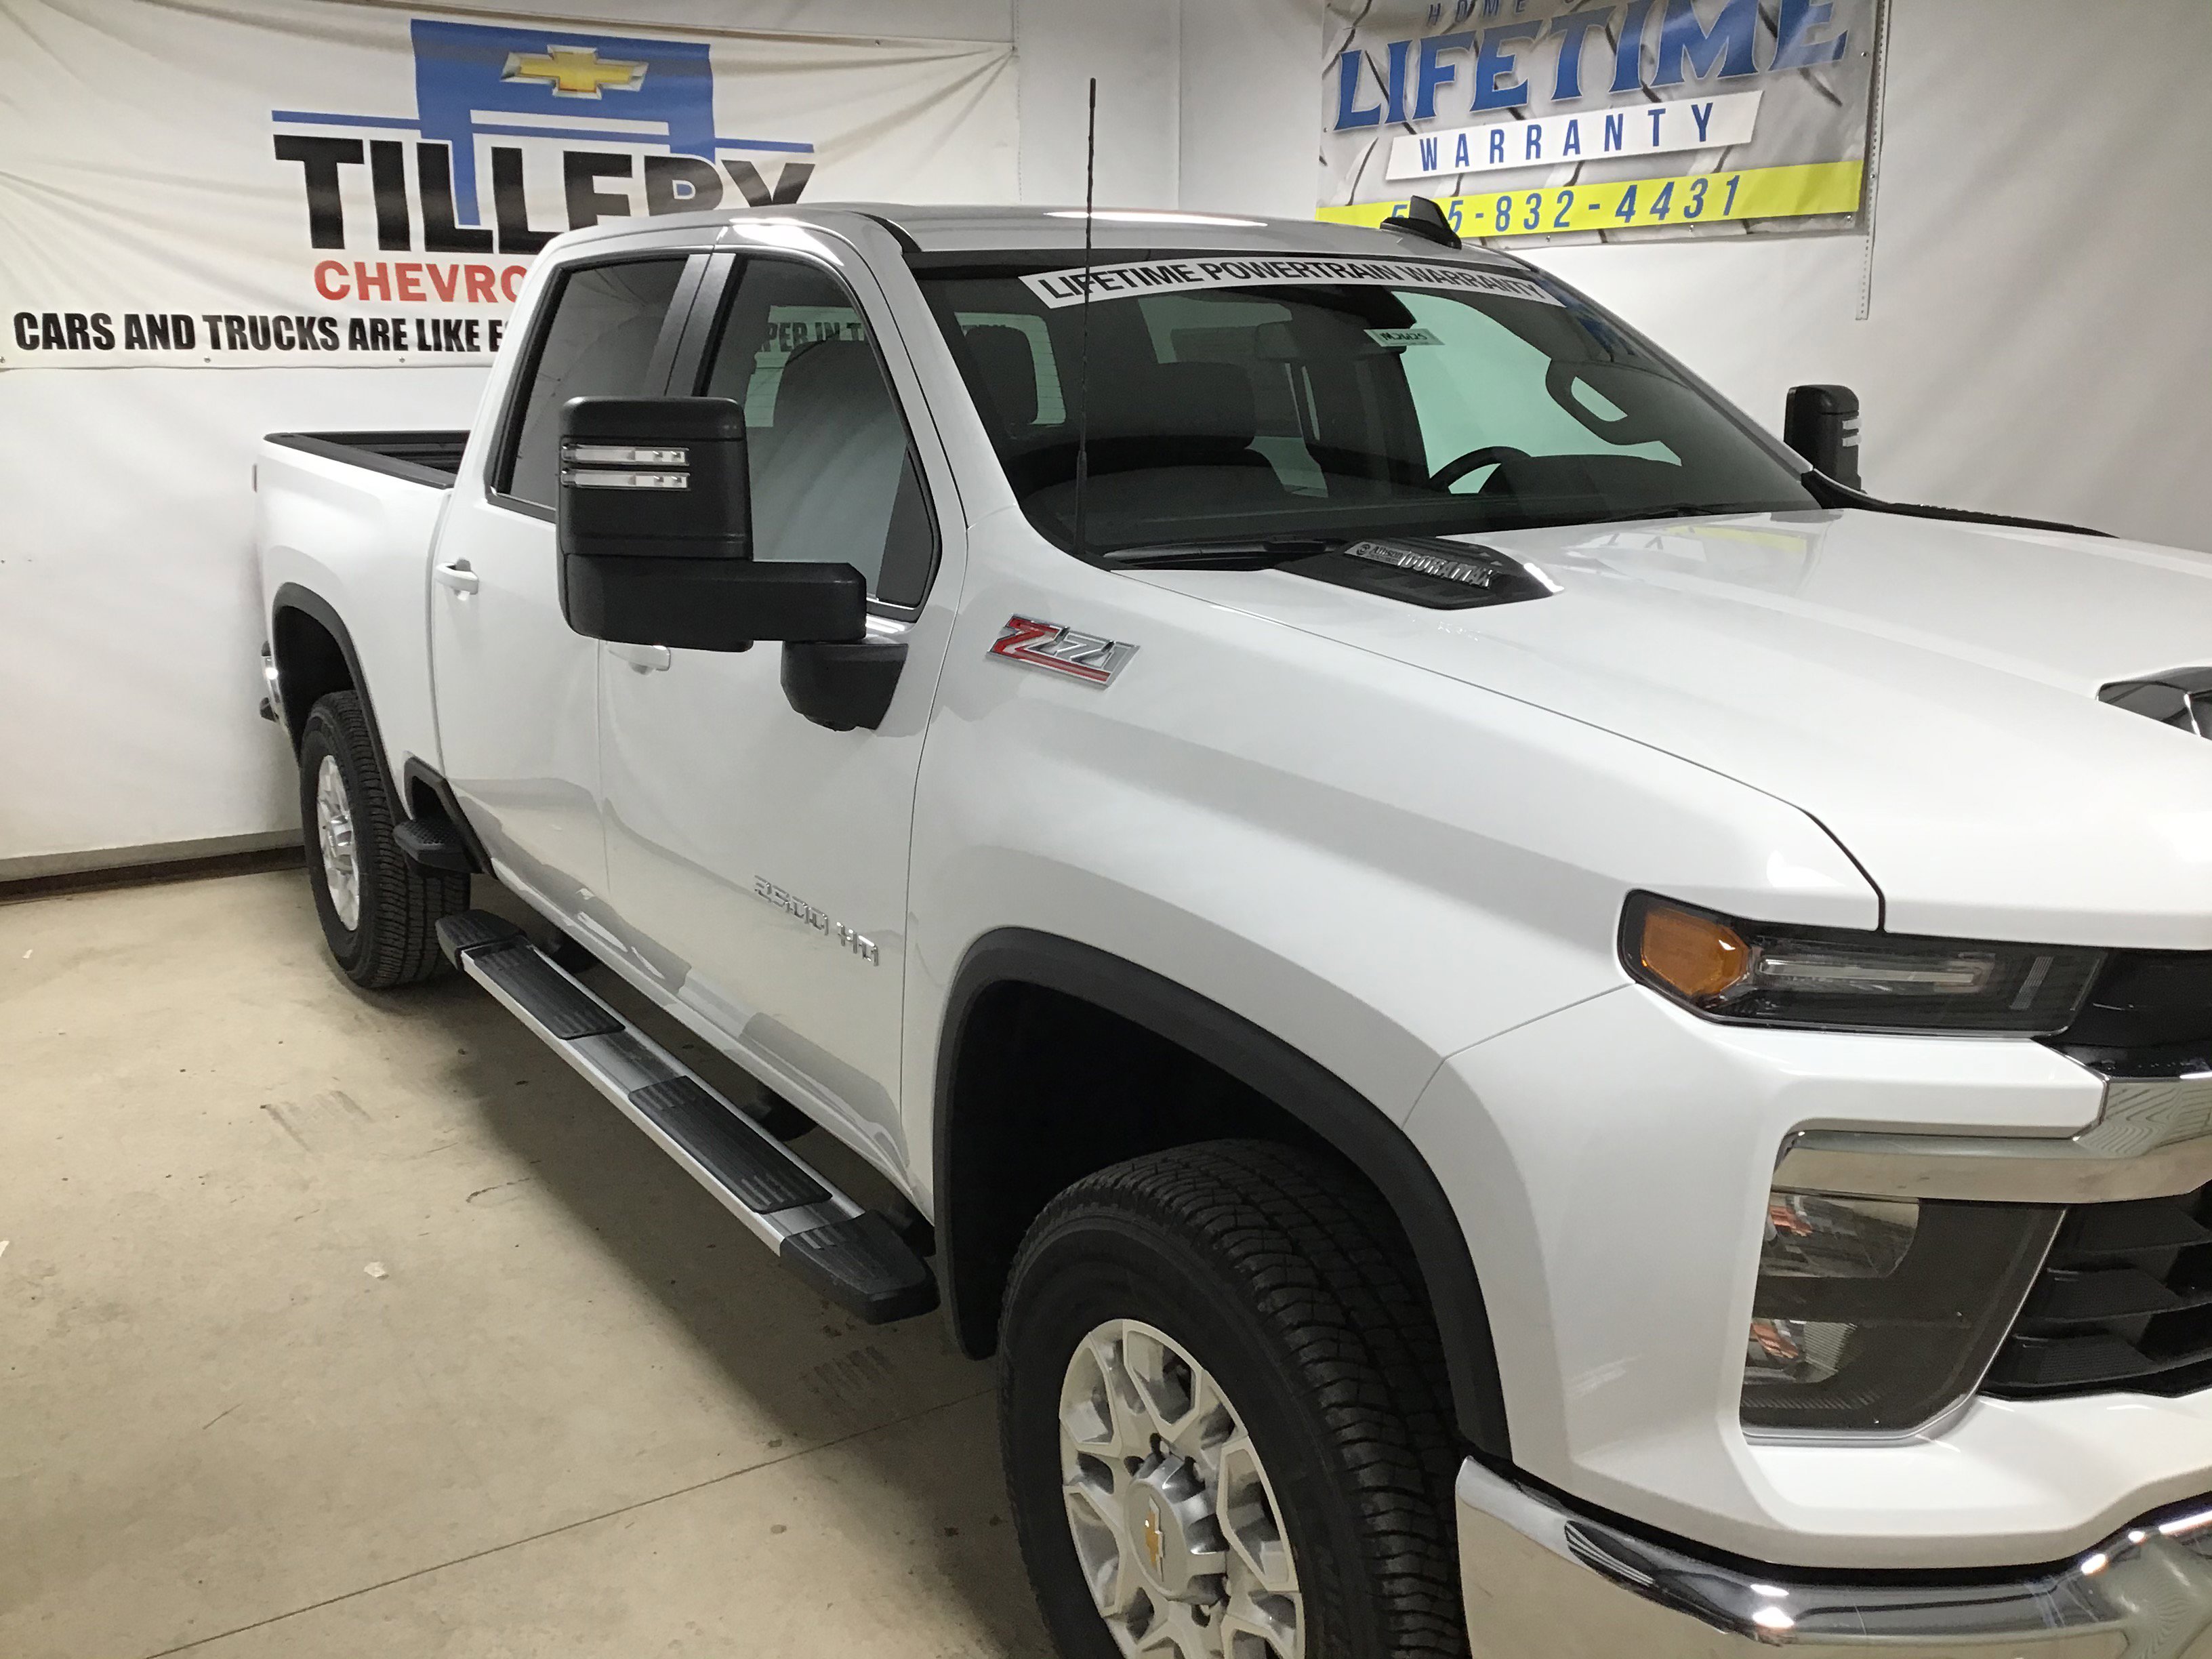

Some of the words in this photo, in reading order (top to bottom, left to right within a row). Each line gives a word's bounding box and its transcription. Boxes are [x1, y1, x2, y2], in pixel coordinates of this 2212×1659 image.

[1333, 0, 1848, 130] LIFETIME
[1420, 102, 1714, 172] WARRANTY
[1038, 264, 1204, 299] LIFETIME
[1197, 261, 1405, 281] POWERTRAIN
[1395, 265, 1546, 300] WARRANTY
[14, 312, 115, 350] CARS
[124, 314, 196, 350] AND
[202, 314, 340, 351] TRUCKS
[348, 318, 409, 351] ARE
[415, 318, 480, 352] LIKE
[837, 922, 879, 967] HD
